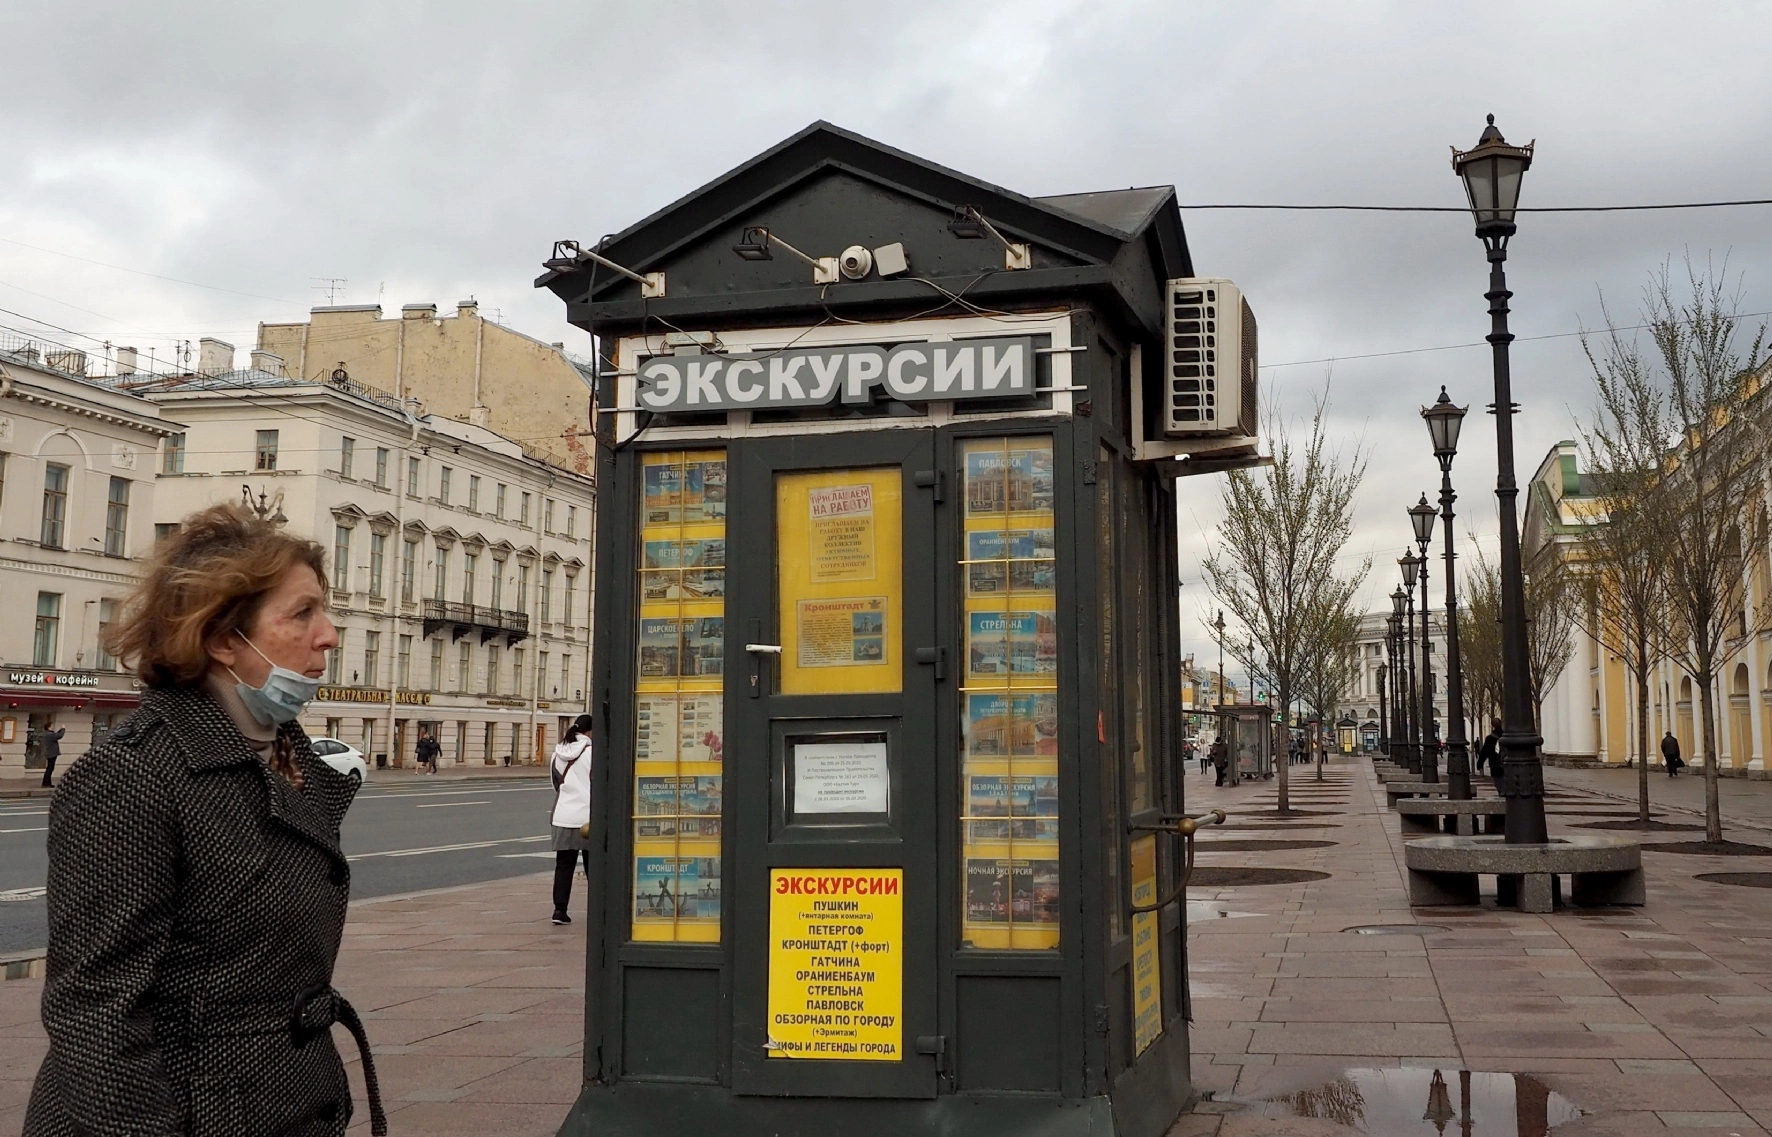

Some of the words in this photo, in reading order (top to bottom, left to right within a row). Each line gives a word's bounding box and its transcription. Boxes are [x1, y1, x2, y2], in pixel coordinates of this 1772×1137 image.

[643, 344, 1023, 406] ЭКСКУРСИИ
[979, 458, 1021, 468] ПАВЛОВСК
[811, 489, 868, 504] ПРИГЛАШАЕМ
[813, 504, 827, 515] НА
[830, 497, 869, 513] РАБОТУ
[979, 537, 1020, 545] ОРАНИЕНАУМ
[658, 548, 694, 557] ПЕТЕРОФ
[804, 602, 865, 613] Кронштадт
[647, 624, 677, 634] ЦАРСКОЕ
[11, 673, 44, 684] музей
[55, 675, 99, 686] кофейня
[330, 689, 388, 703] ТЕАТРАЛЬНАЯ
[968, 867, 995, 875] НОЧНАЯ
[776, 877, 898, 895] ЭКСКУРСИИ
[813, 901, 859, 911] ПУШКИН
[799, 912, 839, 920] (+янтарная
[840, 912, 874, 921] комната)
[808, 925, 864, 935] ПЕТЕРГОФ
[782, 940, 848, 952] КРОНШТАДТ
[851, 941, 890, 953] (+форт)
[811, 957, 860, 967] ГАТЧИНА
[796, 971, 875, 982] ОРАНИЕНБАУМ
[808, 985, 863, 996] СТРЕЛЬНА
[806, 1000, 864, 1011] ПАВЛОВСК
[775, 1014, 832, 1025] ОБЗОРНАЯ
[835, 1015, 850, 1025] ПО
[854, 1015, 895, 1028] ГОРОДУ
[812, 1028, 857, 1038] (+Эрмитаж)
[805, 1042, 812, 1051] И
[814, 1042, 857, 1054] ЛЕГЕНДЫ
[860, 1043, 896, 1054] ГОРОДА
